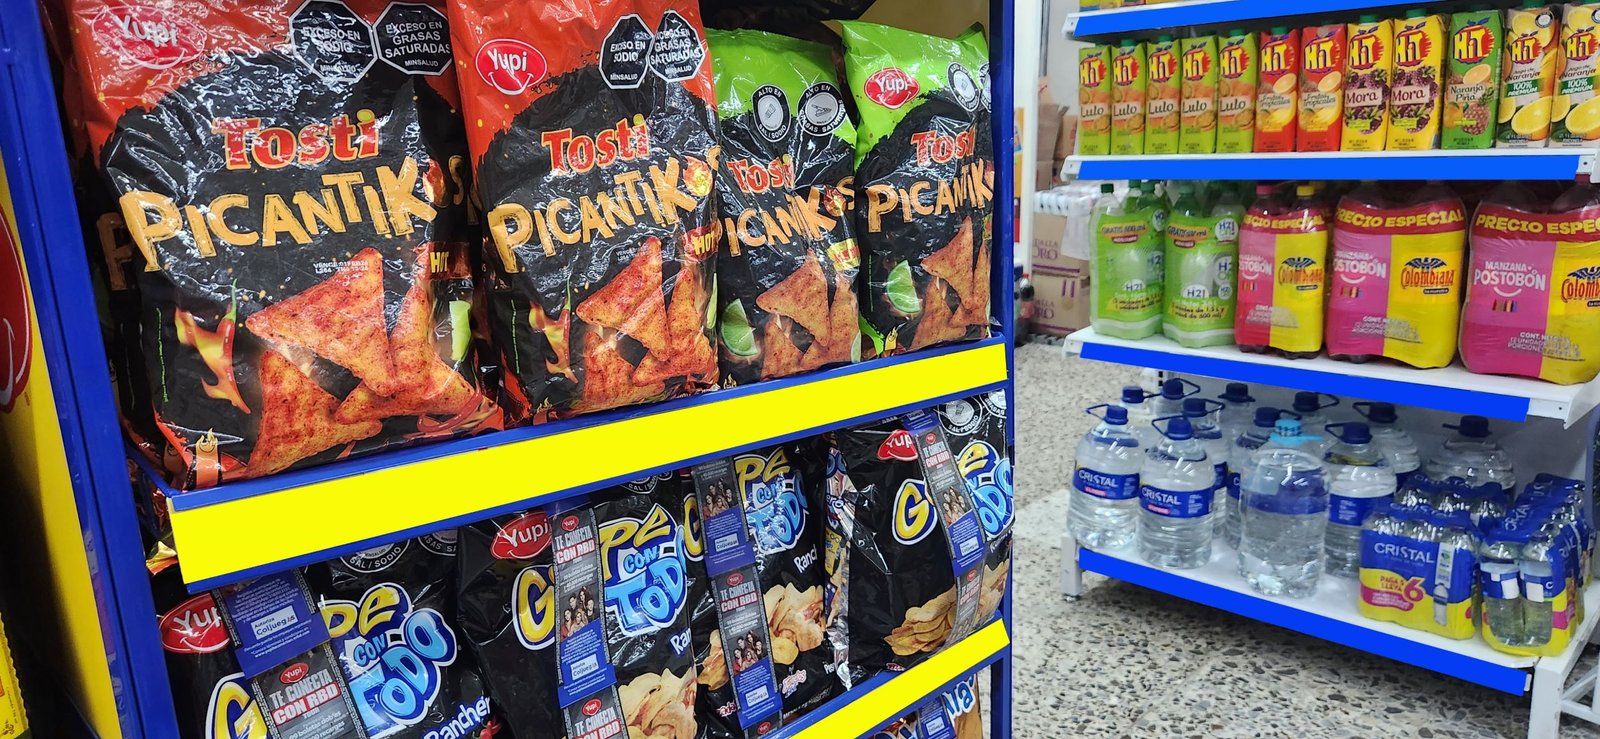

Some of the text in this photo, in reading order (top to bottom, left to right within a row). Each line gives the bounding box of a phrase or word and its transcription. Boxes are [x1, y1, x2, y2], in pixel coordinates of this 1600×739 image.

[385, 21, 443, 34] EXCESO EN
[347, 29, 361, 40] EN
[392, 31, 441, 45] GRASAS
[634, 41, 646, 50] EN
[654, 38, 692, 52] GRASAS
[404, 59, 439, 67] MINSALUD
[486, 48, 528, 76] Yupi
[651, 48, 702, 65] SATURADAS
[1508, 71, 1541, 80] Naranja
[1562, 69, 1597, 79] Naranja
[1450, 84, 1484, 95] Naranja
[1513, 81, 1533, 90] 100%
[1562, 85, 1594, 95] PREMIUM
[1567, 79, 1588, 88] 100%
[758, 87, 783, 98] ALTO EN
[805, 86, 819, 98] ALTO
[1392, 89, 1426, 104] Mora
[1508, 87, 1538, 96] PREMIUM
[1346, 92, 1378, 105] Mora
[1081, 104, 1104, 117] Lulo
[1113, 104, 1137, 116] Lulo
[1148, 101, 1174, 114] Lulo
[1182, 101, 1207, 113] Lulo
[1220, 99, 1246, 112] Lulo
[771, 125, 787, 139] SODIO
[212, 108, 380, 171] Tosti
[542, 113, 652, 175] Tosti
[1385, 209, 1464, 228] ESPECIAL
[1475, 214, 1544, 233] PRECIO
[1485, 260, 1527, 271] MANZANA
[1400, 267, 1455, 289] Colombiana
[1079, 470, 1119, 488] CRISTAL
[1142, 487, 1182, 506] CRISTAL
[508, 518, 552, 547] Yupi
[374, 547, 402, 568] SODIO
[556, 545, 577, 564] CON
[1374, 542, 1436, 564] CRISTAL
[1404, 577, 1425, 602] 6
[721, 598, 740, 613] CON
[285, 666, 303, 679] Yupi
[269, 669, 333, 709] TE CONECTA
[273, 683, 339, 726] CON RBD
